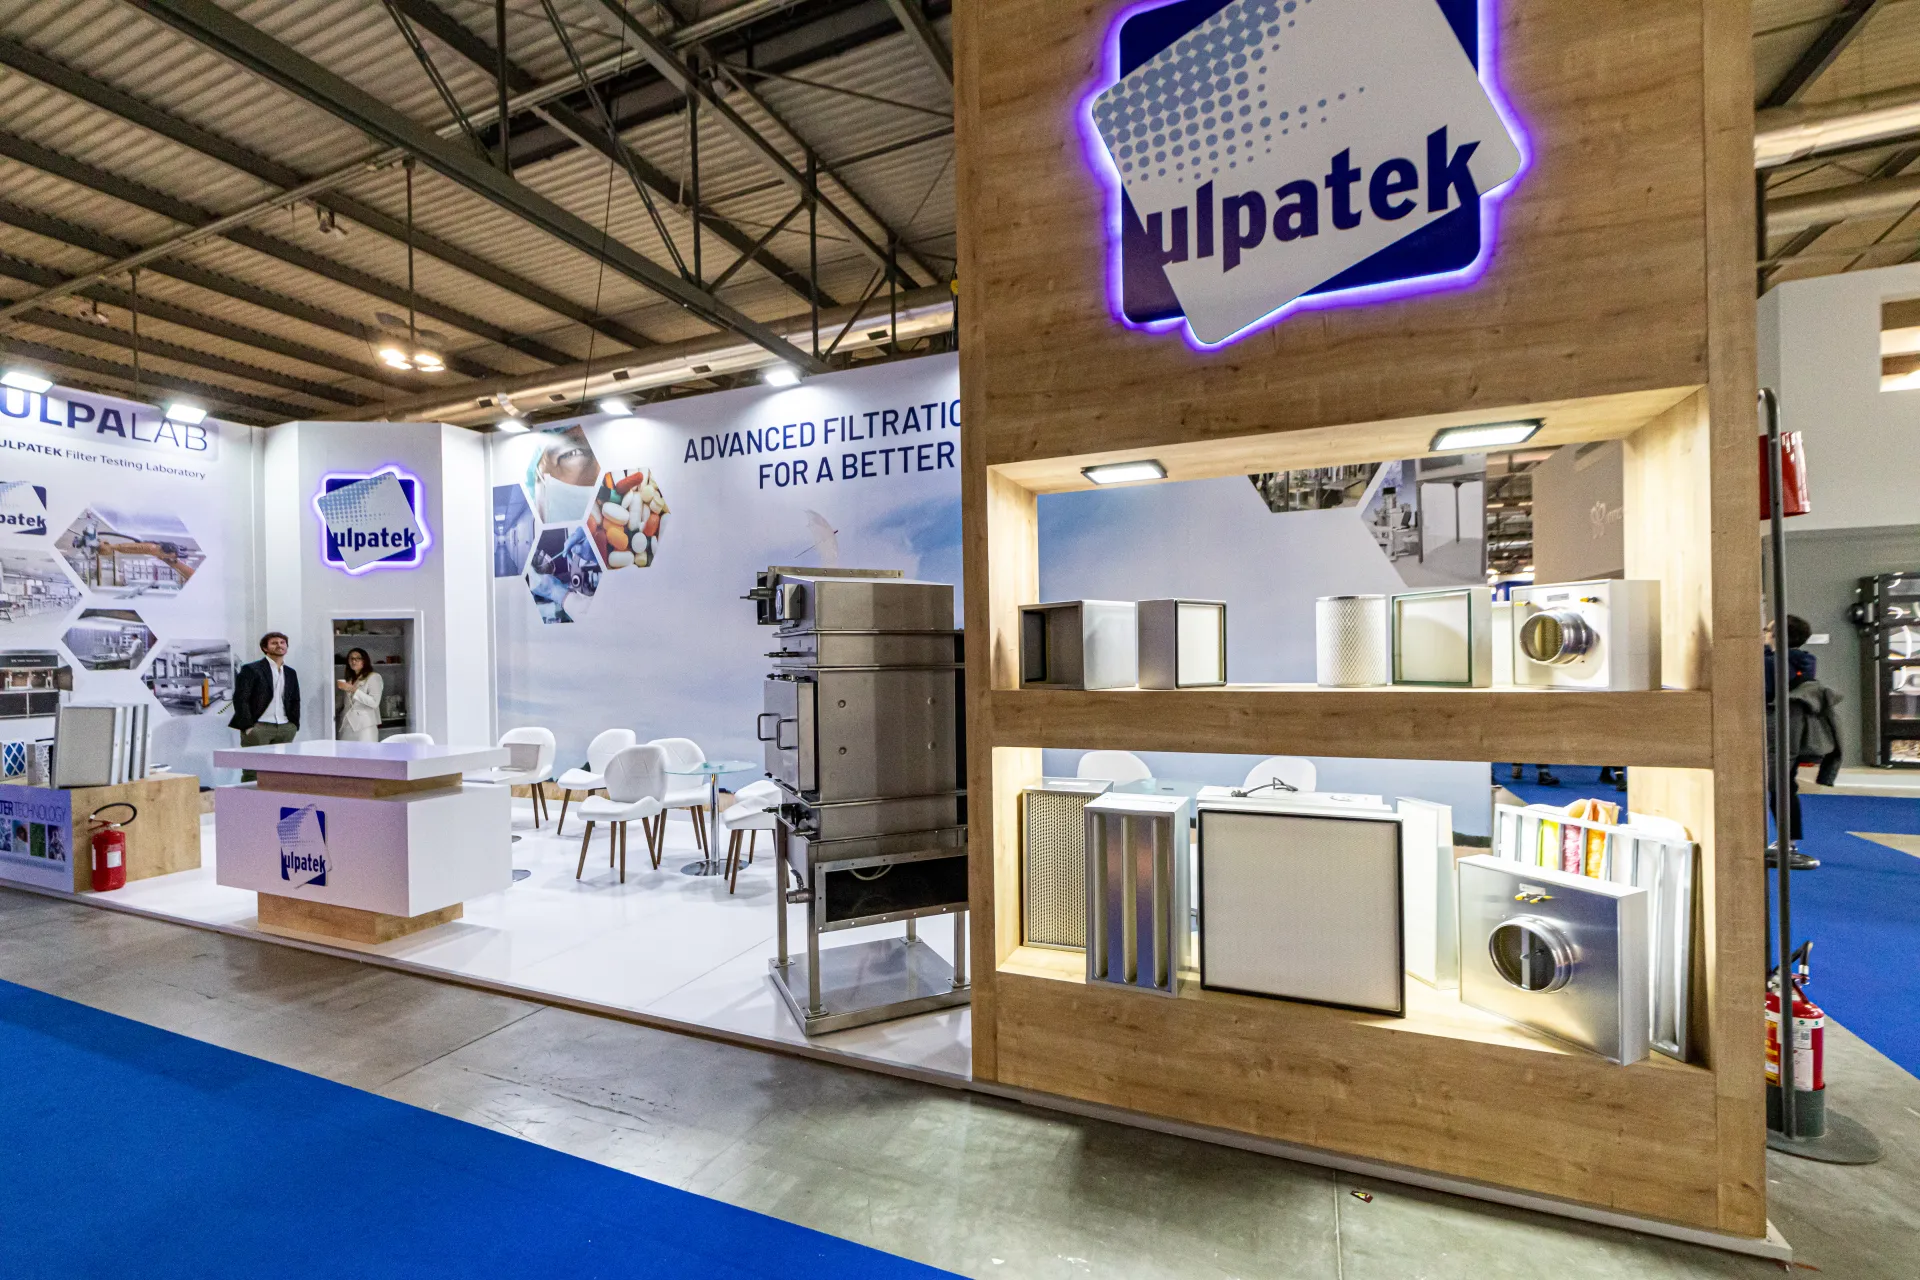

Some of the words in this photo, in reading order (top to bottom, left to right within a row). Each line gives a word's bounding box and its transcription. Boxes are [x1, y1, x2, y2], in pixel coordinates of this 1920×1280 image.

[1146, 125, 1481, 273] ulpatek
[684, 420, 816, 464] ADVANCED
[65, 449, 97, 463] Filter
[100, 454, 143, 472] Testing
[146, 462, 206, 480] Laboratory
[759, 459, 808, 490] FOR
[816, 456, 834, 484] A
[842, 441, 955, 480] BETTER
[333, 527, 415, 552] ulpatek
[284, 851, 325, 873] ulpatek
